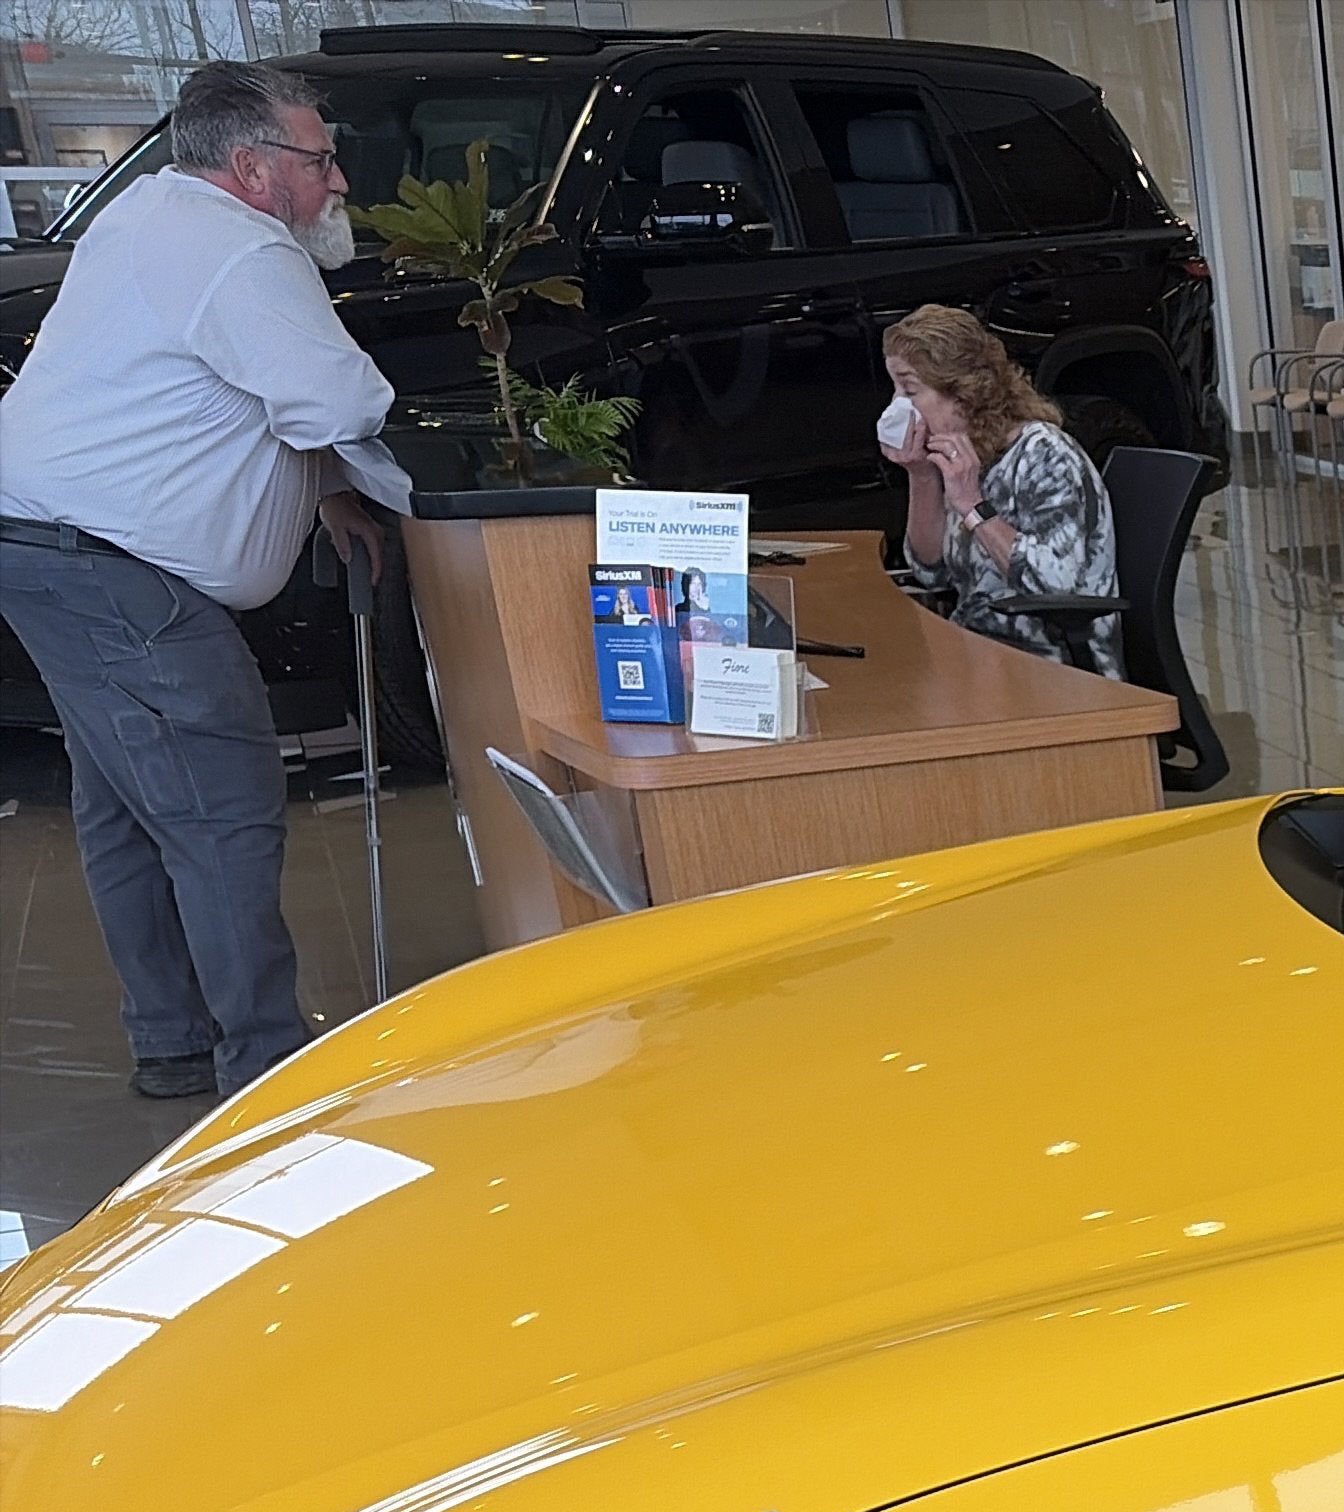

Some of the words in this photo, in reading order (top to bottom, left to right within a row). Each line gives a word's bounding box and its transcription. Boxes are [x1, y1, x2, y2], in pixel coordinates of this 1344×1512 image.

[696, 501, 736, 511] SiriusXM
[609, 521, 655, 533] LISTEN
[659, 522, 739, 537] ANYWHERE
[595, 571, 642, 581] SiriusXM
[721, 658, 749, 675] Fiore
